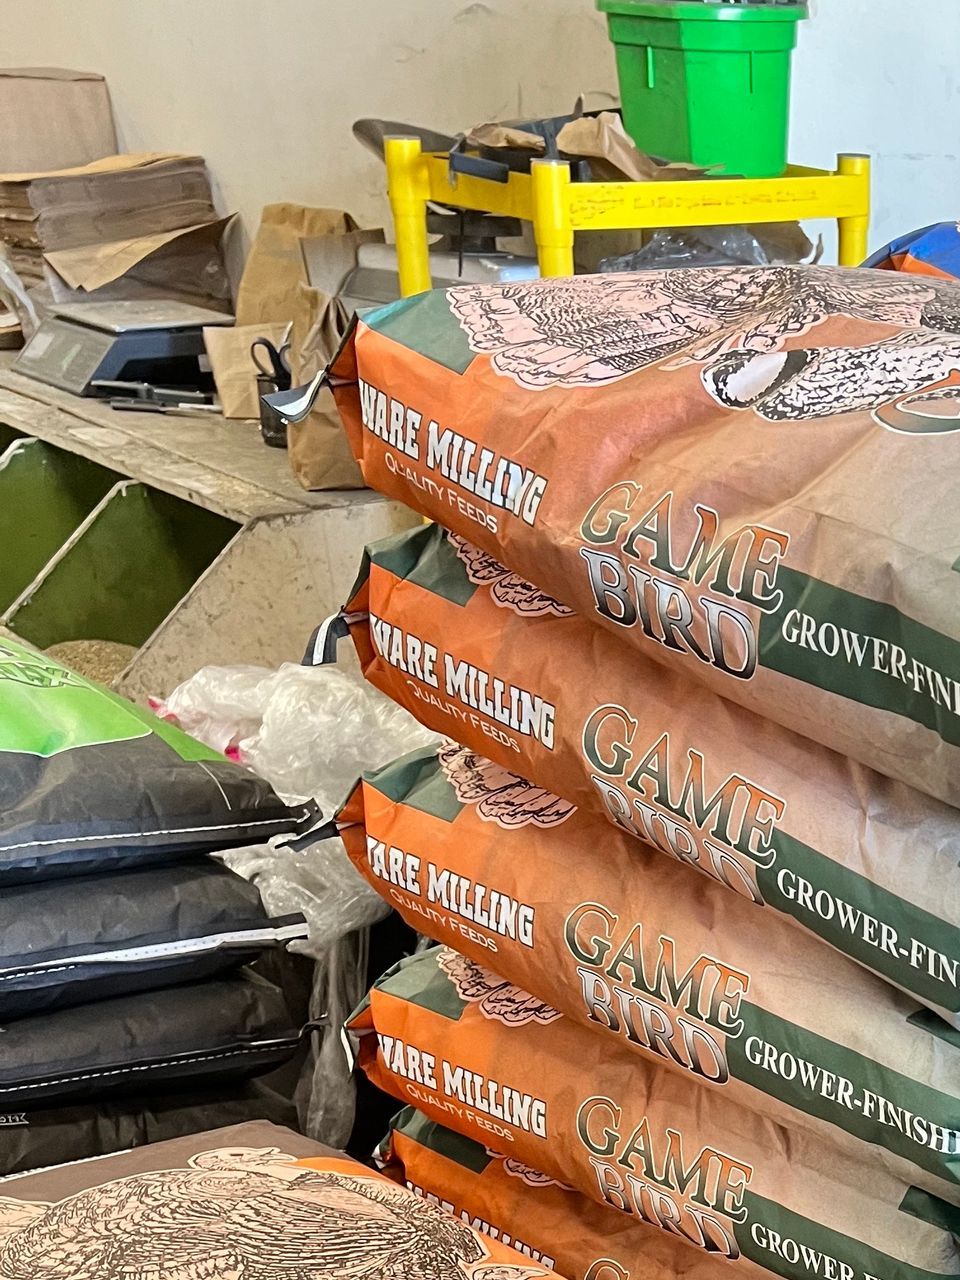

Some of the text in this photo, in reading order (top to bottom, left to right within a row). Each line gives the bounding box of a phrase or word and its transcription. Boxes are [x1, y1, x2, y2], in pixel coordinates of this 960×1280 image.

[358, 377, 549, 527] WARE MILLING
[385, 452, 498, 534] QUALITY FEEDS
[580, 480, 790, 615] GAME
[580, 548, 760, 681] BIRD
[444, 652, 556, 751] MILLING
[470, 715, 521, 753] FEEDS
[582, 704, 787, 868] GAME
[390, 888, 499, 953] QUALITY FEEDS
[427, 862, 535, 949] MILLING
[562, 902, 750, 1040] GAME
[575, 966, 731, 1086] BIRD
[406, 1084, 515, 1142] QUALITY FEEDS
[442, 1061, 548, 1139] MILLING
[576, 1096, 753, 1226] GAME
[588, 1152, 742, 1262] BIRD
